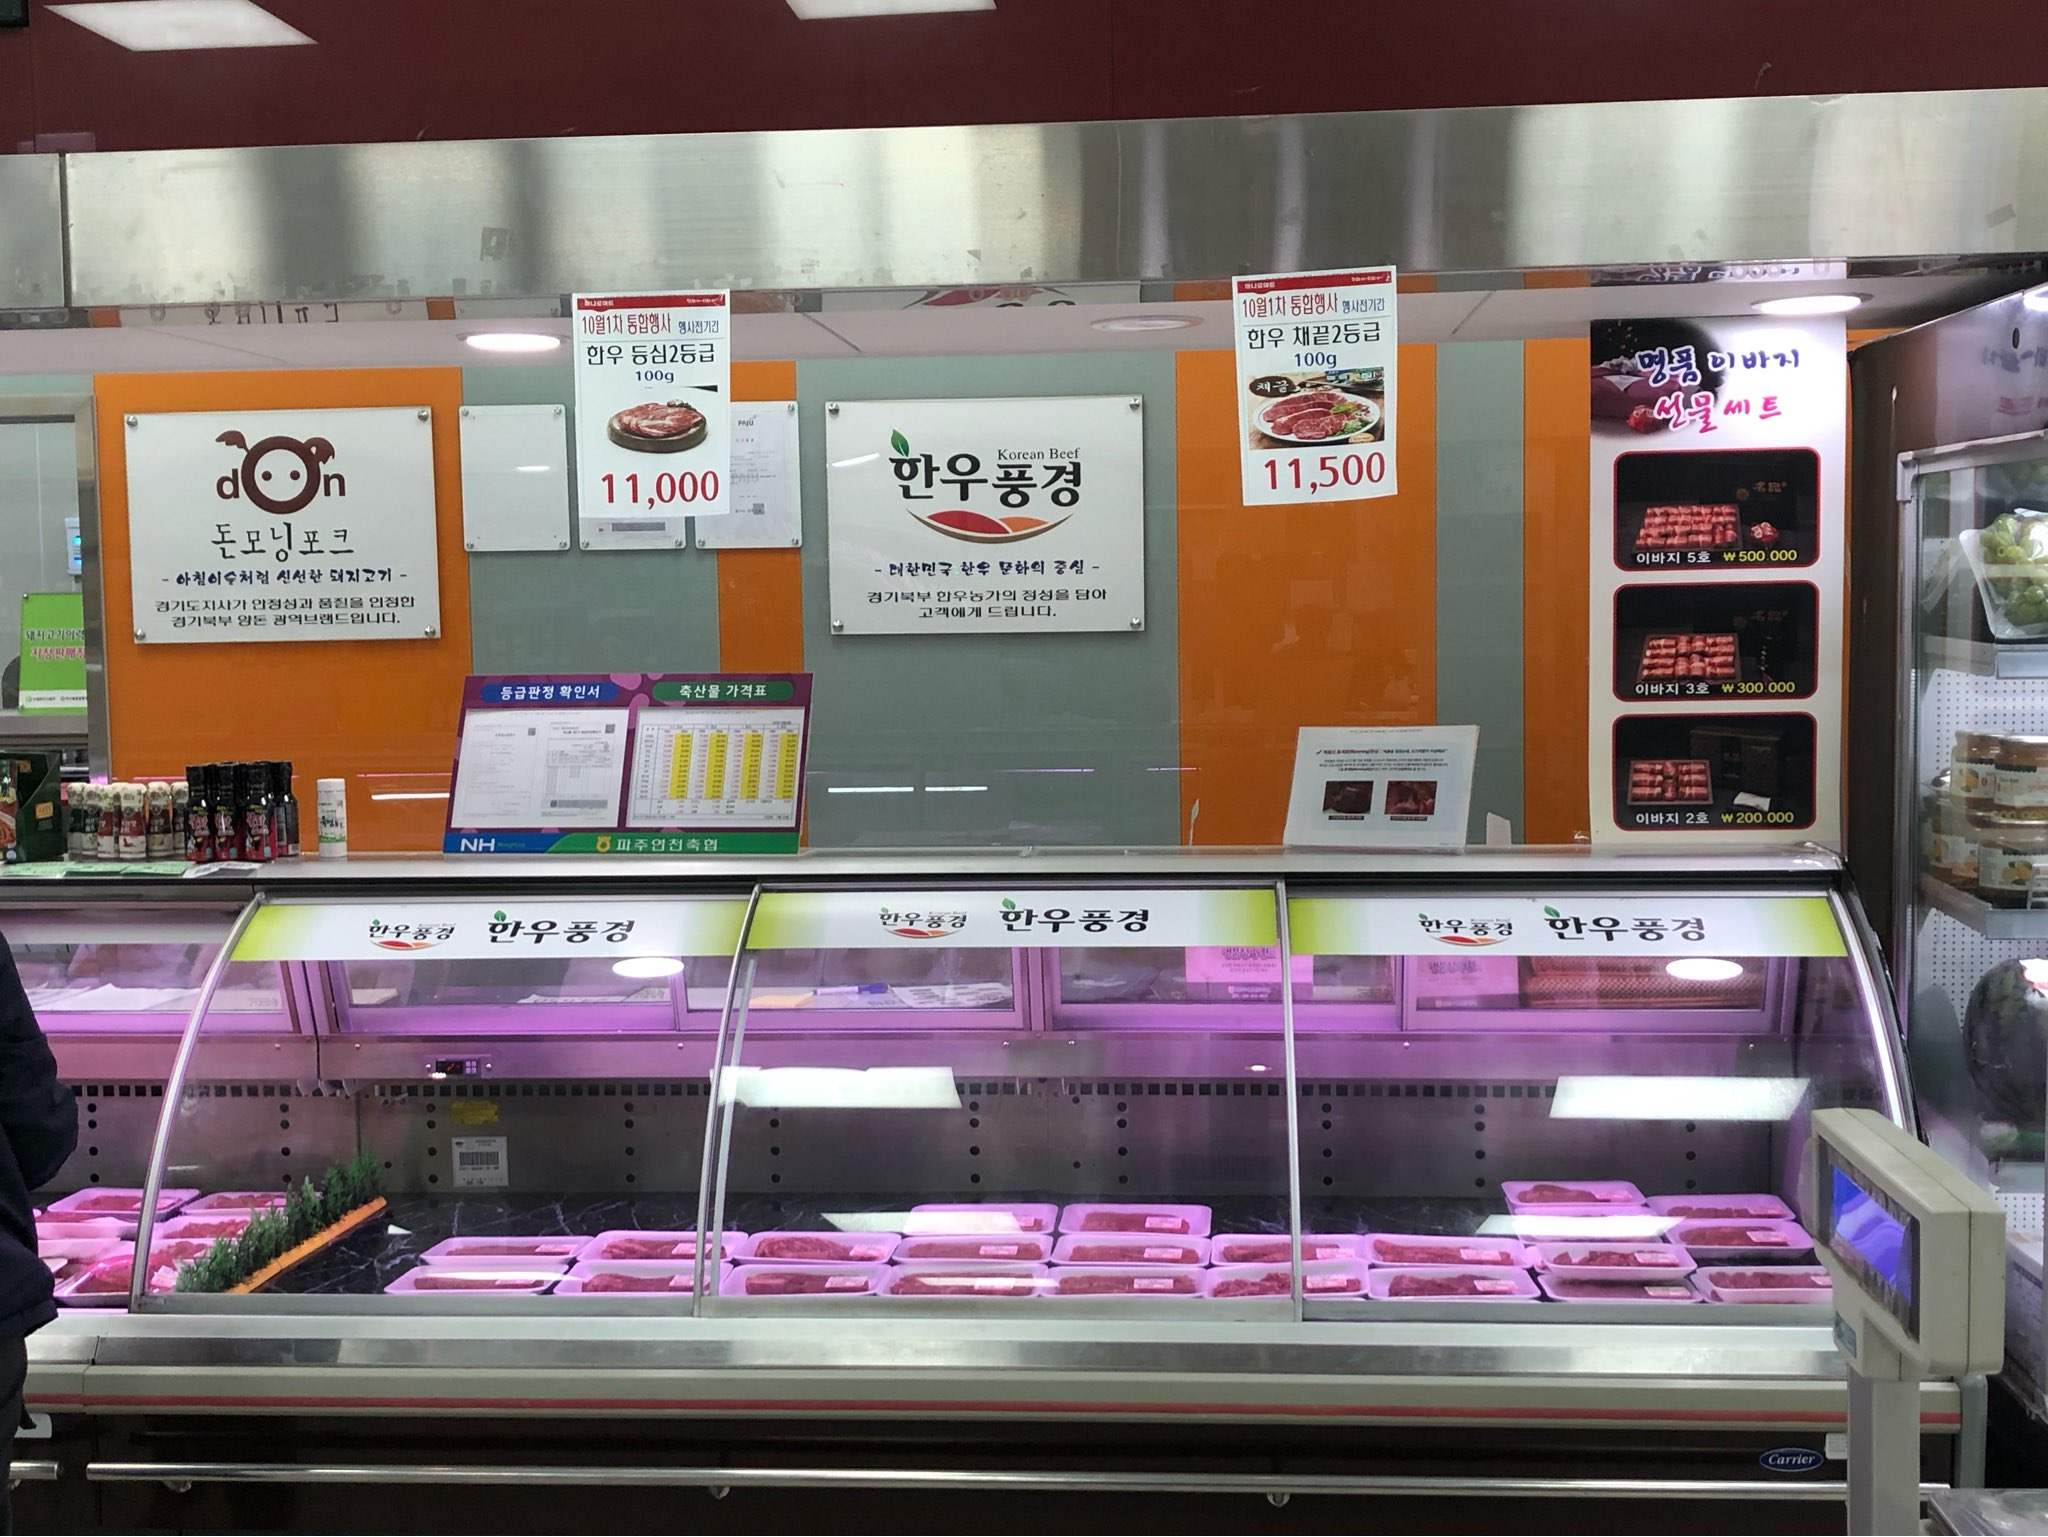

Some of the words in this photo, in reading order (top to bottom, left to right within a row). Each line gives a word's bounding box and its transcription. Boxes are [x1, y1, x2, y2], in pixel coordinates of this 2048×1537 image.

[1242, 295, 1286, 318] 10월1차
[1290, 292, 1339, 317] 통합행사
[1341, 297, 1385, 315] 행사전기간
[582, 314, 623, 335] 10월1차
[627, 312, 671, 335] 통합행사
[678, 320, 720, 334] 행사전기간
[1247, 327, 1285, 350] 한우
[1292, 321, 1381, 347] 채끝2등급
[586, 345, 624, 366] 한우
[631, 343, 715, 366] 등심2등급
[1294, 351, 1337, 368] 100g
[1637, 345, 1700, 385] 명품
[1709, 348, 1800, 370] 이바지
[635, 369, 674, 384] 100g
[997, 448, 1045, 461] Korean
[1048, 447, 1081, 461] Beef
[889, 453, 1083, 508] 한우풍경
[1264, 451, 1386, 495] 11,500
[600, 470, 720, 510] 11,000
[211, 521, 355, 563] 돈모닝포크
[1636, 551, 1681, 565] 이바지
[1687, 551, 1712, 564] 5호
[276, 568, 323, 585] 신선한
[329, 567, 392, 583] 돼지고기
[889, 561, 953, 577] 대한민국
[960, 560, 991, 577] 한우
[999, 559, 1045, 576] 문화의
[1053, 559, 1084, 575] 중심
[155, 599, 247, 613] 경기도지사가
[251, 597, 313, 611] 안정성과
[318, 596, 364, 610] 품질을
[369, 596, 415, 609] 인정한
[867, 590, 931, 604] 경기북부
[936, 589, 1017, 603] 한우농가의
[1021, 588, 1070, 602] 정성을
[1074, 588, 1107, 601] 담아
[918, 606, 983, 618] 고객에게
[987, 604, 1057, 618] 드립니다.
[172, 615, 233, 628] 경기북부
[273, 612, 401, 626] 광역브랜드입니다.
[500, 685, 555, 701] 등급판정
[559, 684, 601, 700] 확인서
[679, 684, 721, 699] 축산물
[725, 684, 768, 698] 가격표
[1635, 682, 1680, 696] 이바지
[1685, 682, 1710, 695] 3호
[1635, 811, 1680, 825] 이바지
[1685, 812, 1710, 825] 2호
[460, 837, 496, 852] NH
[616, 838, 719, 852] 파주연천축협
[879, 912, 967, 929] 한우풍경
[1000, 907, 1150, 933] 한우풍경
[1419, 918, 1513, 937] 한우풍경
[1544, 915, 1706, 942] 한우풍경
[369, 924, 455, 941] 한우풍경
[488, 918, 636, 945] 한우풍경
[1768, 1453, 1816, 1465] Carrier
